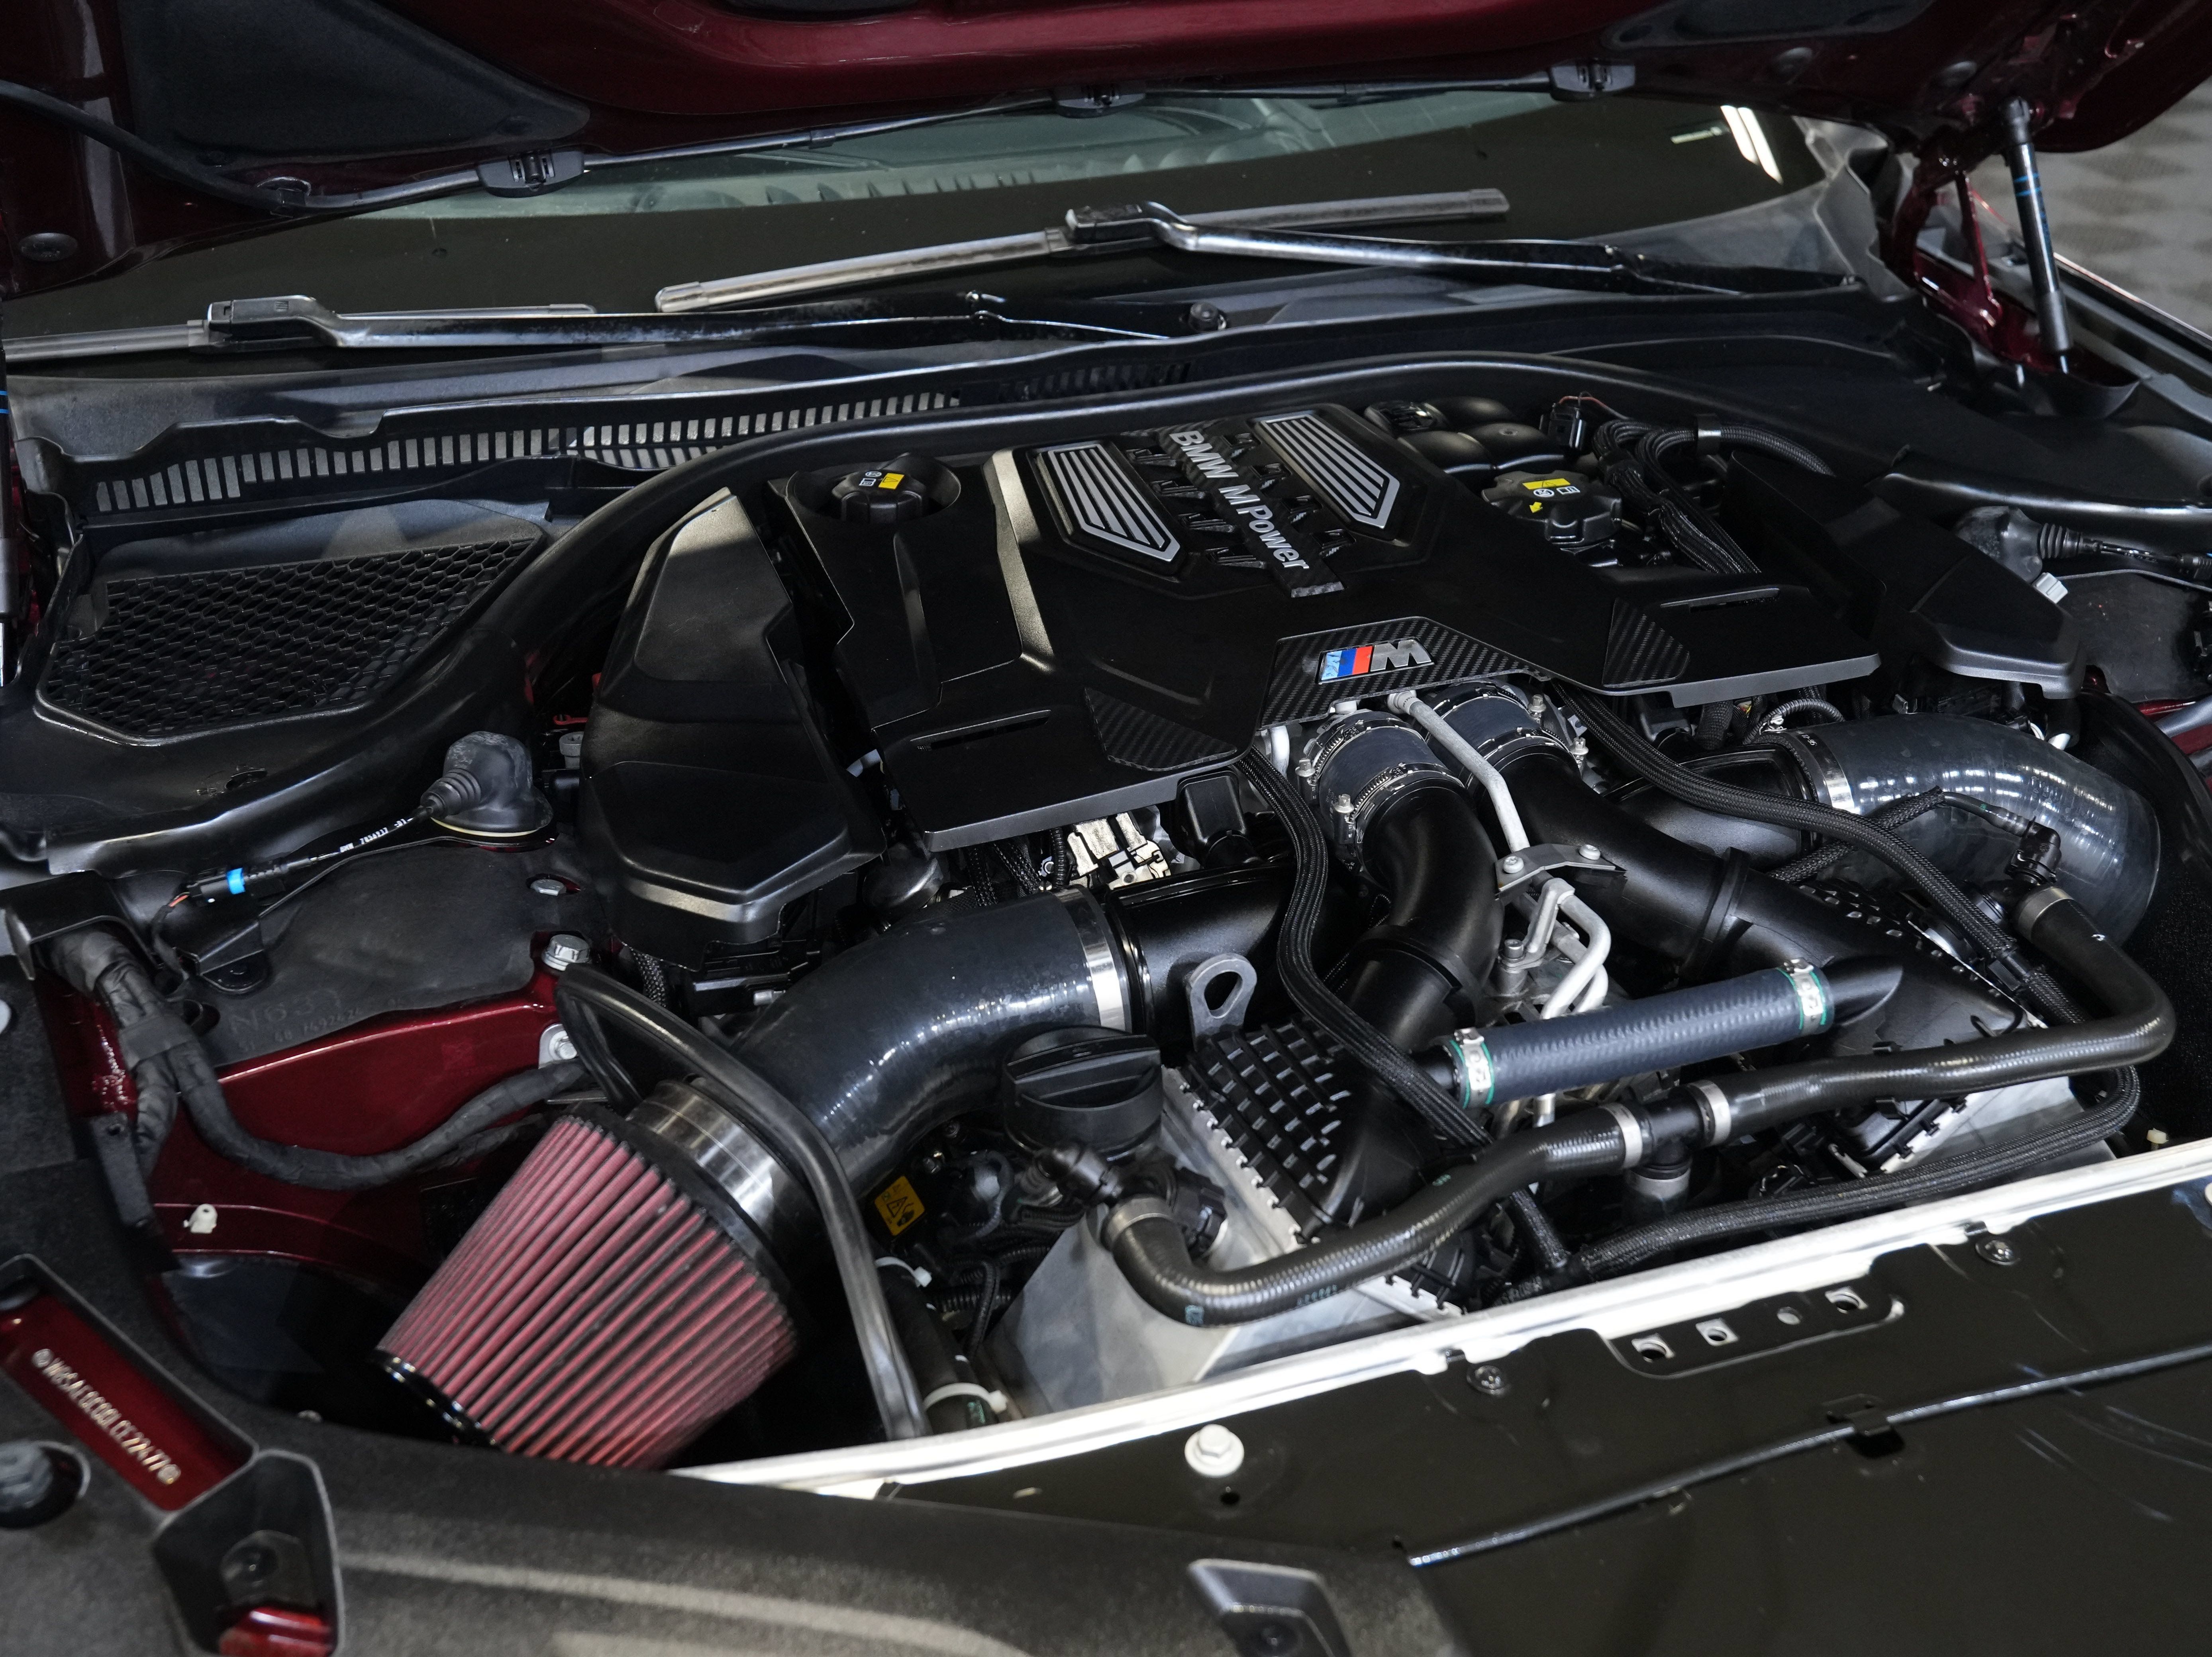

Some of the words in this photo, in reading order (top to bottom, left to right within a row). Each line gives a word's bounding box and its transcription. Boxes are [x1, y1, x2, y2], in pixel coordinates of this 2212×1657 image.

[1169, 430, 1239, 478] BMW
[1218, 484, 1261, 505] M
[1235, 504, 1310, 570] Power
